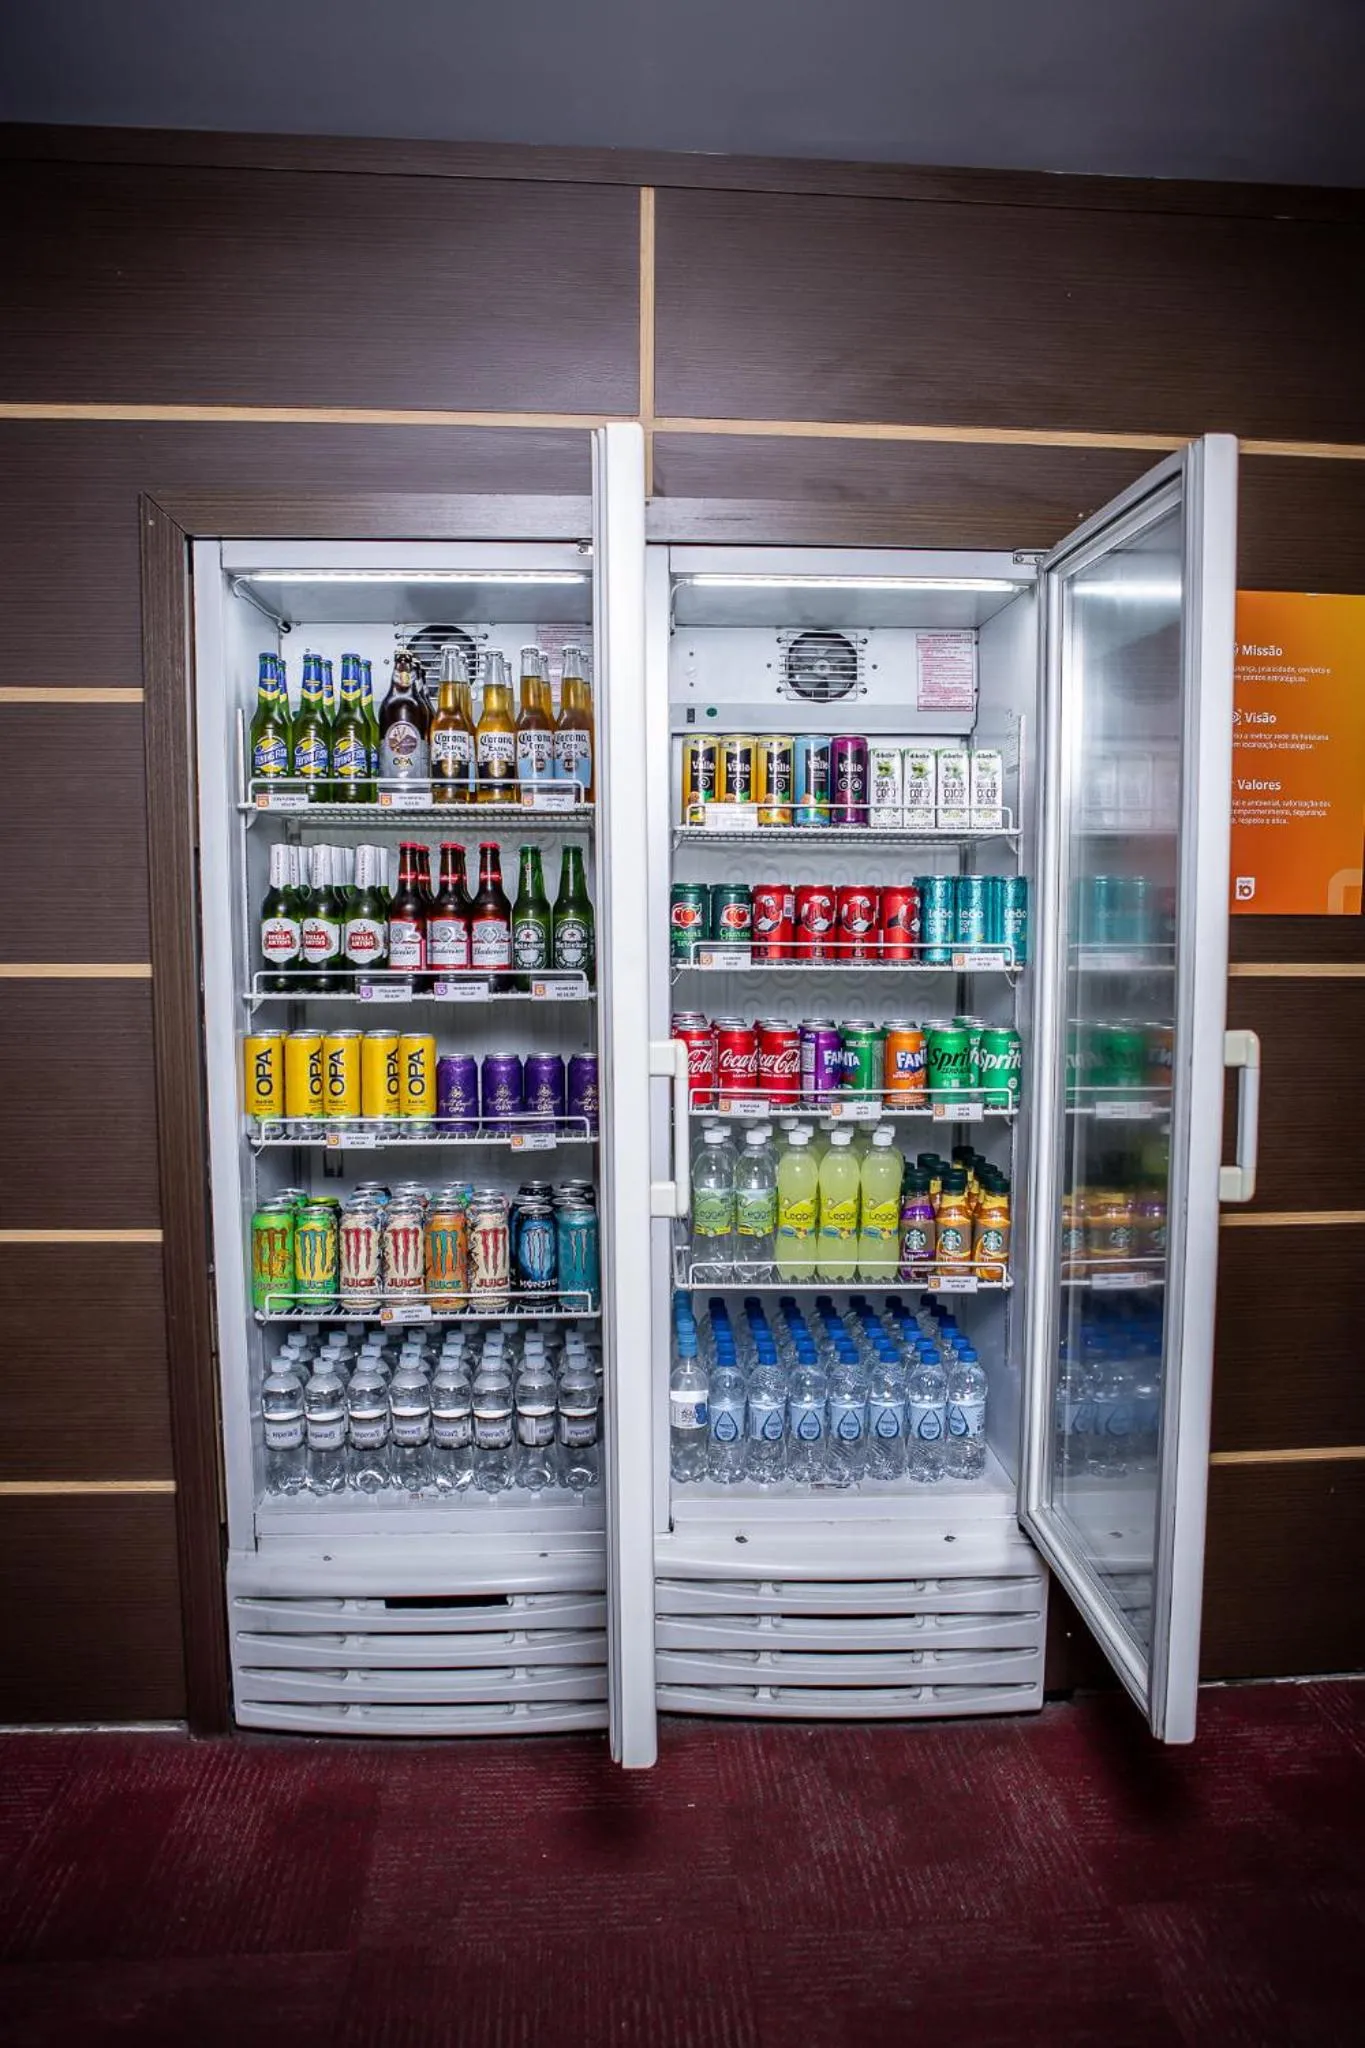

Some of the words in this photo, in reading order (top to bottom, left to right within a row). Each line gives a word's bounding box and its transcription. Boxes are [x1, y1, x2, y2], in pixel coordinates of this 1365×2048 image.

[1242, 644, 1283, 657] Missão
[1244, 712, 1277, 724] Visão
[434, 732, 466, 746] Corona
[480, 734, 512, 746] Corona
[1238, 779, 1281, 791] Valores
[256, 1048, 273, 1096] OPA
[328, 1048, 345, 1096] OPA
[408, 1048, 426, 1096] OPA
[342, 1278, 376, 1288] JUICE
[388, 1278, 422, 1288] JUICE
